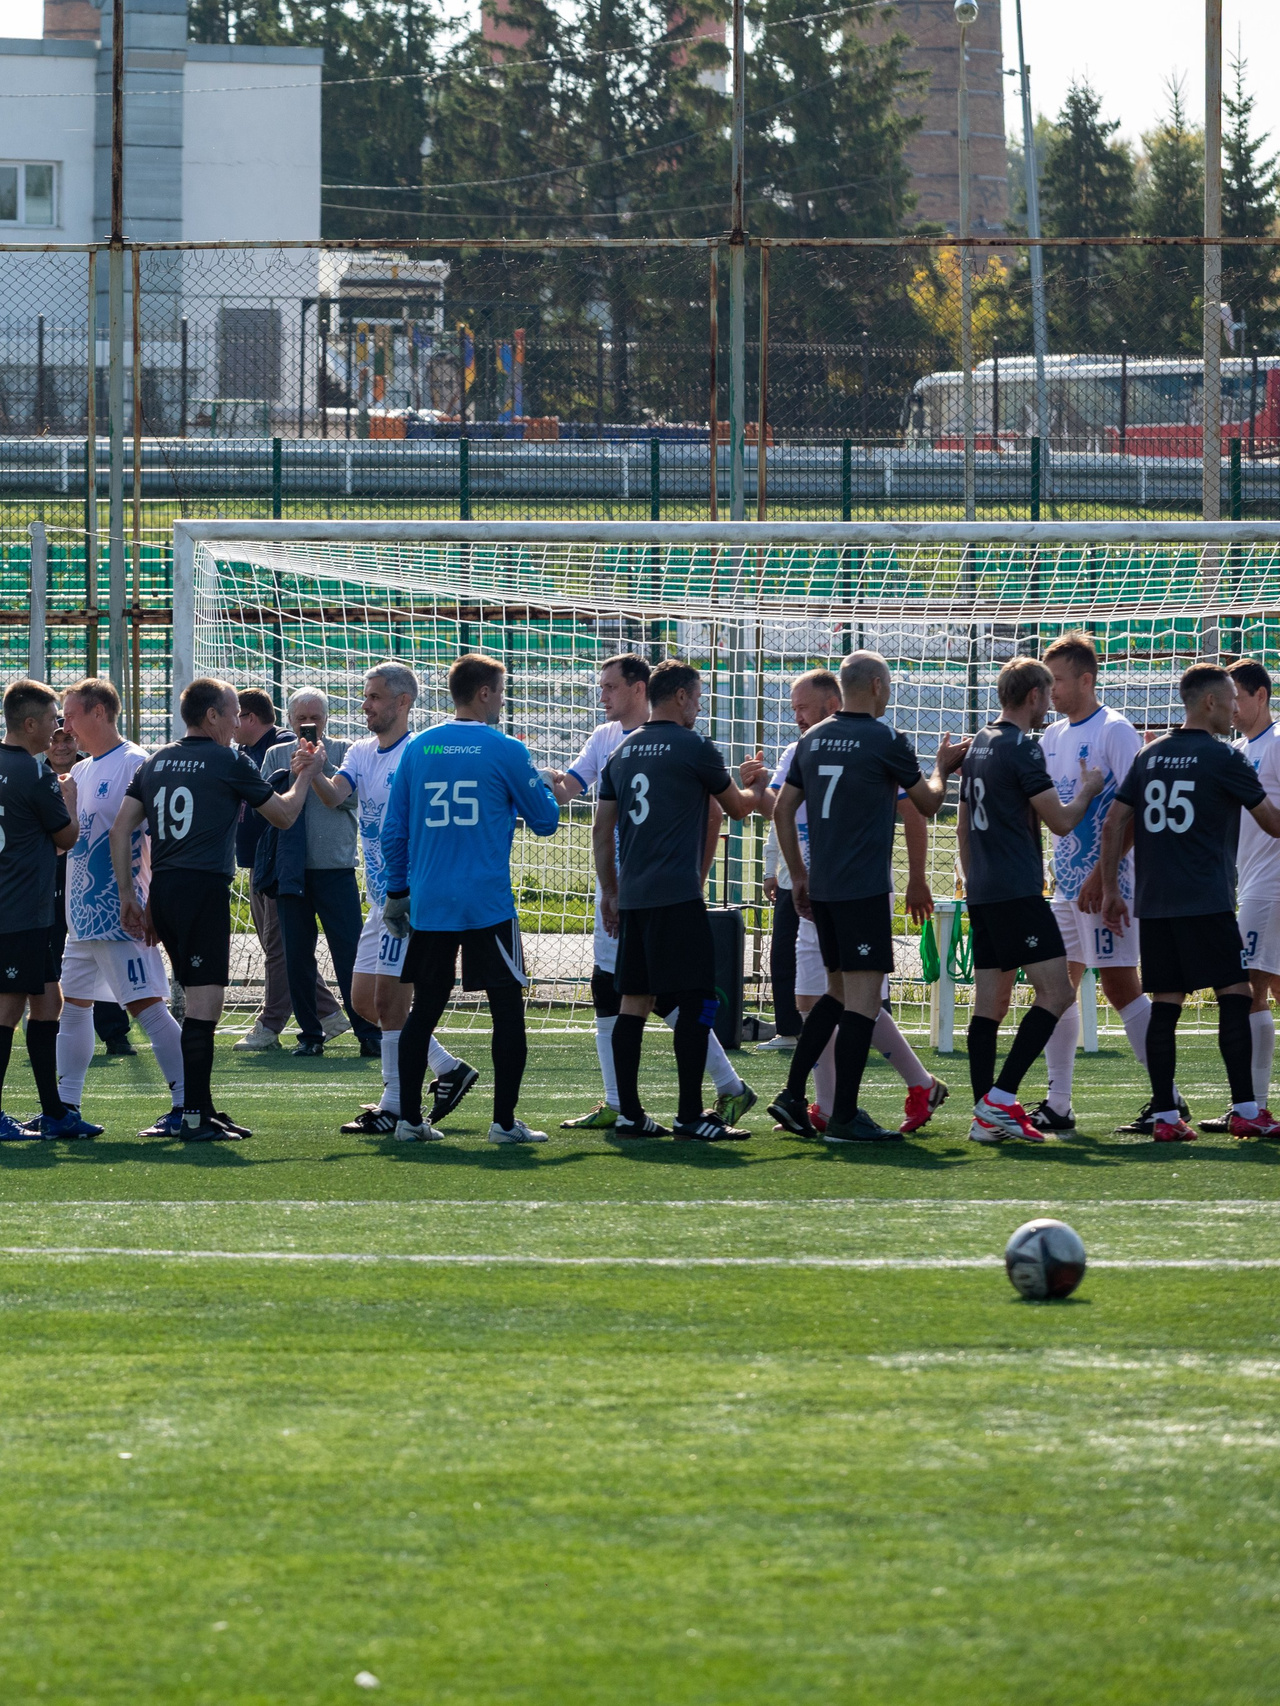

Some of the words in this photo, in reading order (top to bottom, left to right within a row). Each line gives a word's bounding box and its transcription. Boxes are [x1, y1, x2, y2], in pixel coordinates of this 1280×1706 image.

[423, 744, 483, 755] VINSERVICE
[631, 743, 671, 752] РИМЕРА
[1156, 755, 1199, 764] РИМЕРА
[165, 759, 206, 769] РИМЕРА
[423, 780, 480, 828] 35
[628, 772, 650, 826] 3
[818, 764, 845, 819] 7
[153, 785, 195, 840] 19
[1143, 779, 1196, 834] 85
[378, 934, 403, 963] 30
[1094, 927, 1114, 955] 13
[127, 957, 147, 985] 41
